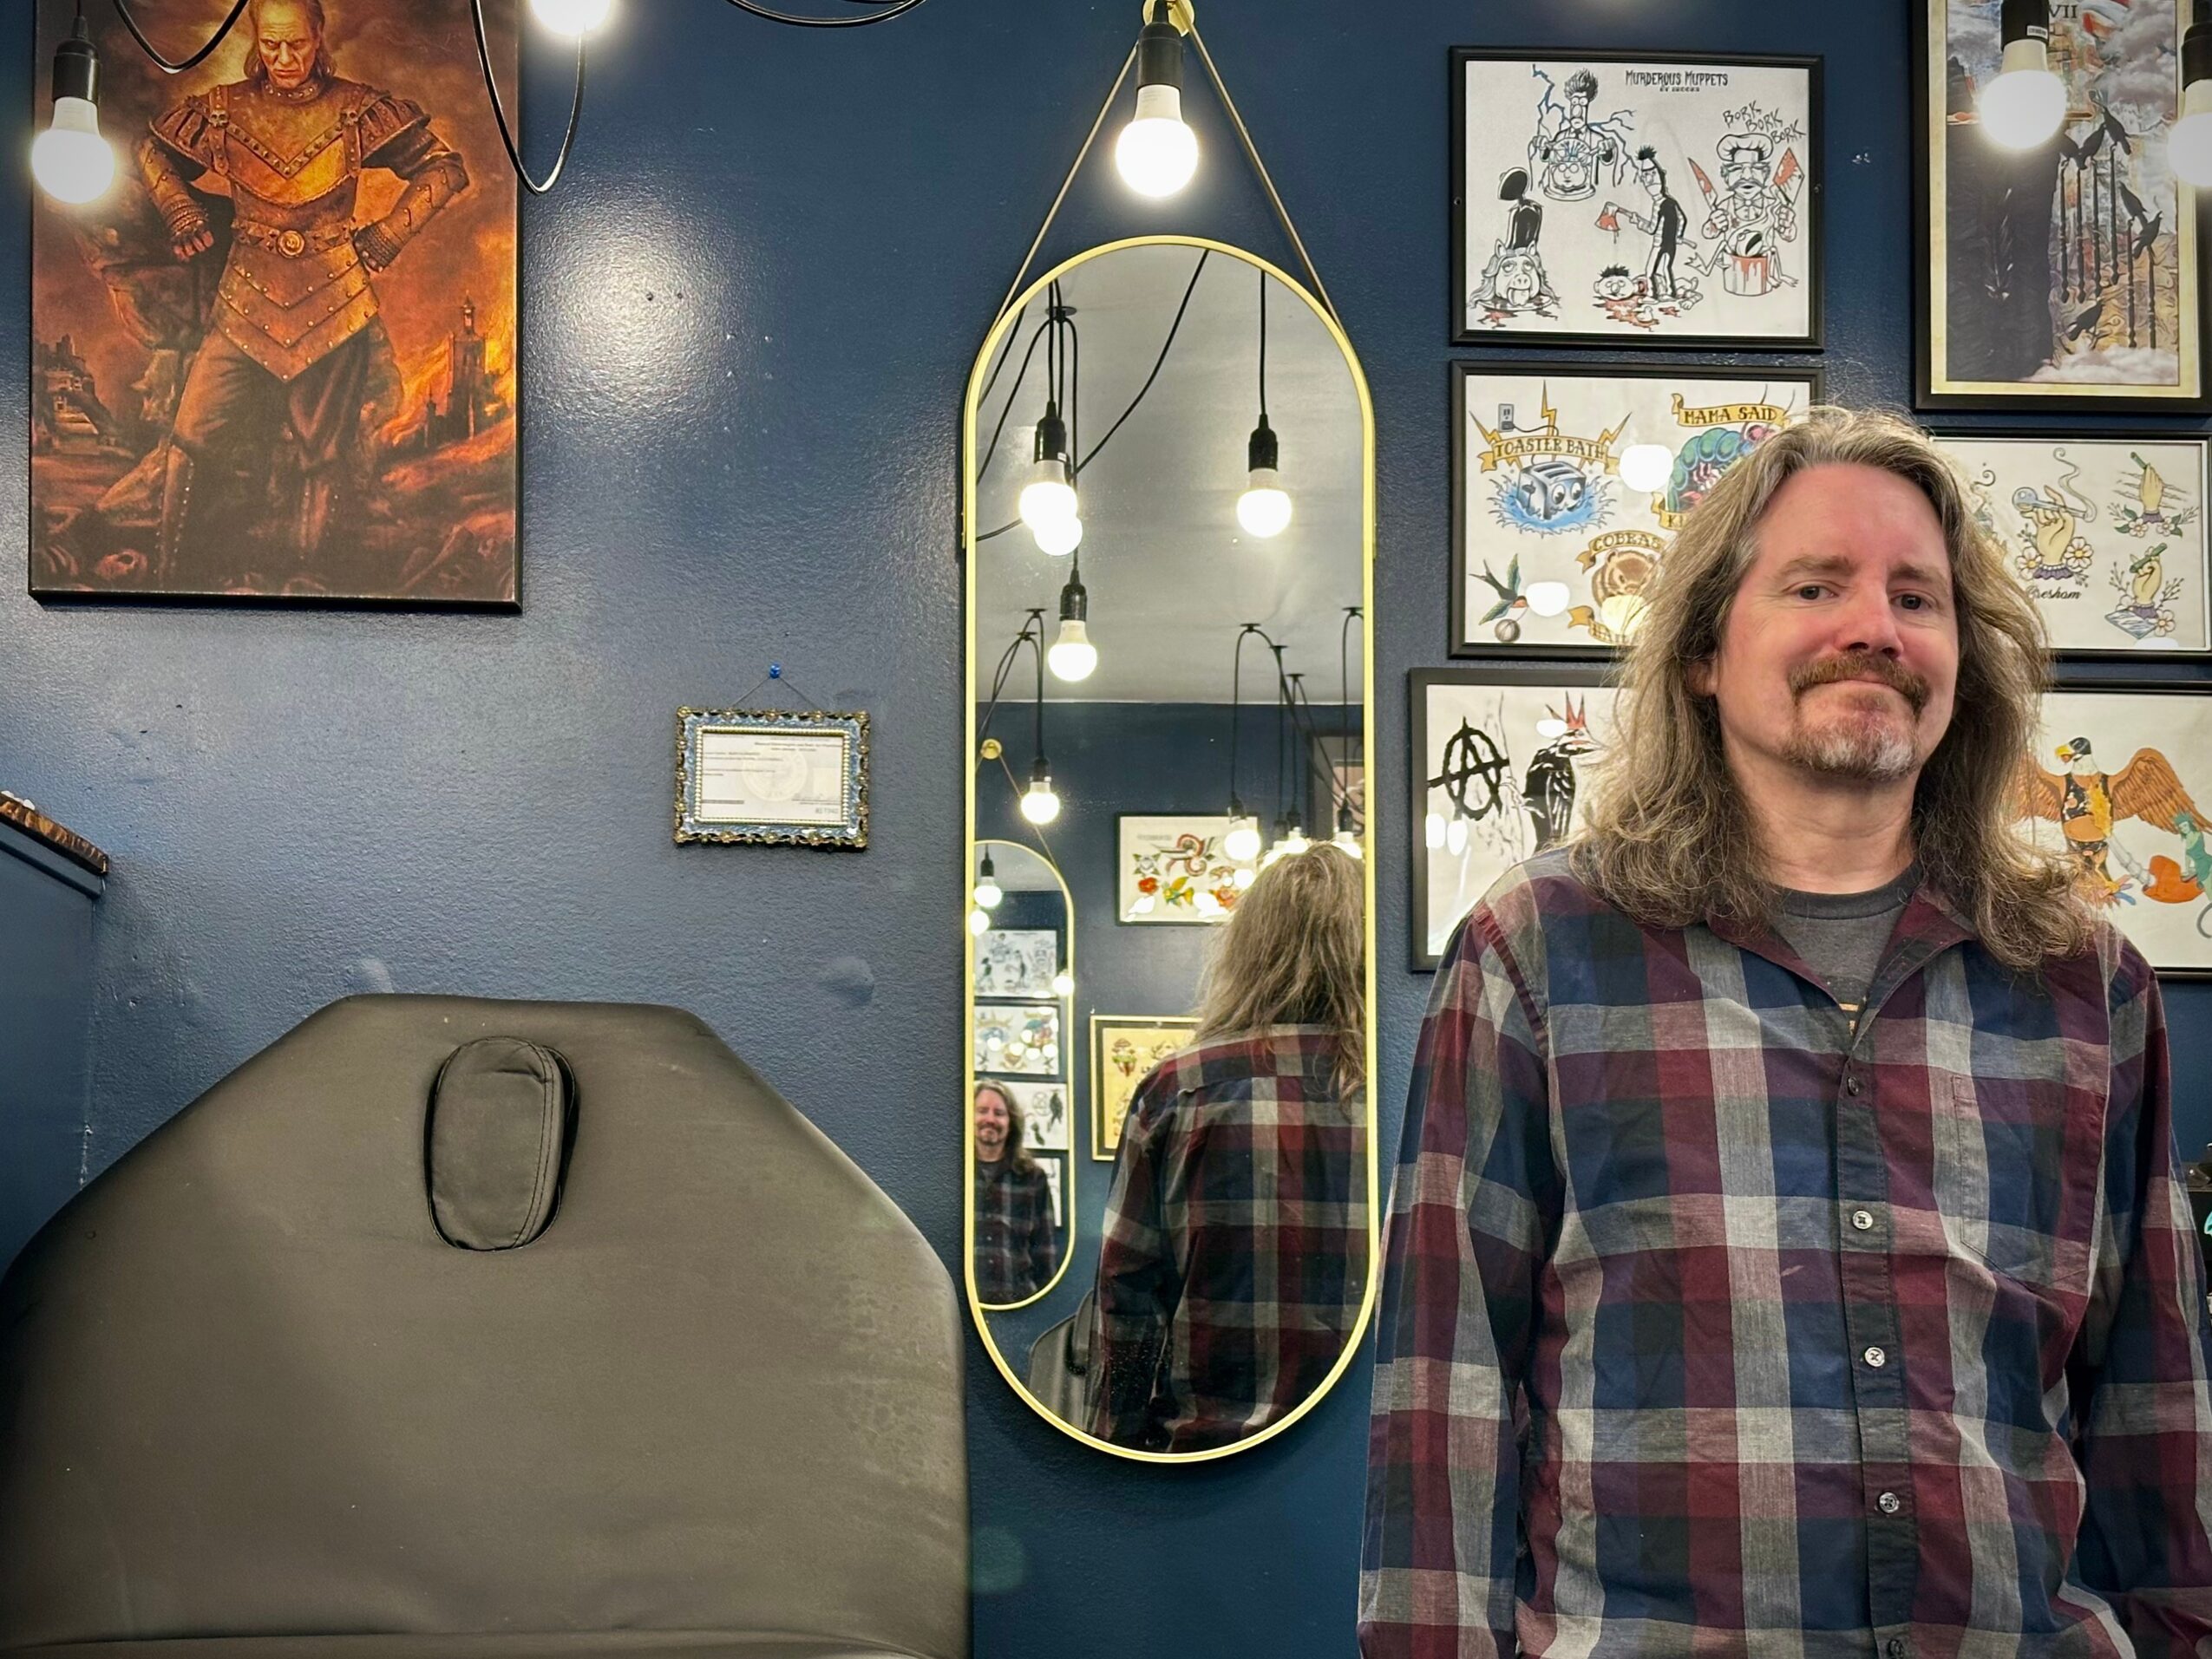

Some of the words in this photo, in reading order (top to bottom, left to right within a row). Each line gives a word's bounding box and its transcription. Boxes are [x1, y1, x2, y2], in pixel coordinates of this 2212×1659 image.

[1625, 69, 1682, 87] MURDEROUS
[1685, 70, 1729, 87] MUPPETS
[1722, 100, 1762, 128] BORK
[1745, 108, 1783, 133] BORK
[1770, 119, 1807, 144] BORK
[1684, 408, 1731, 424] MAMA
[1738, 407, 1777, 421] SAID
[1495, 437, 1562, 457] TOASTER
[1566, 439, 1605, 460] BATH
